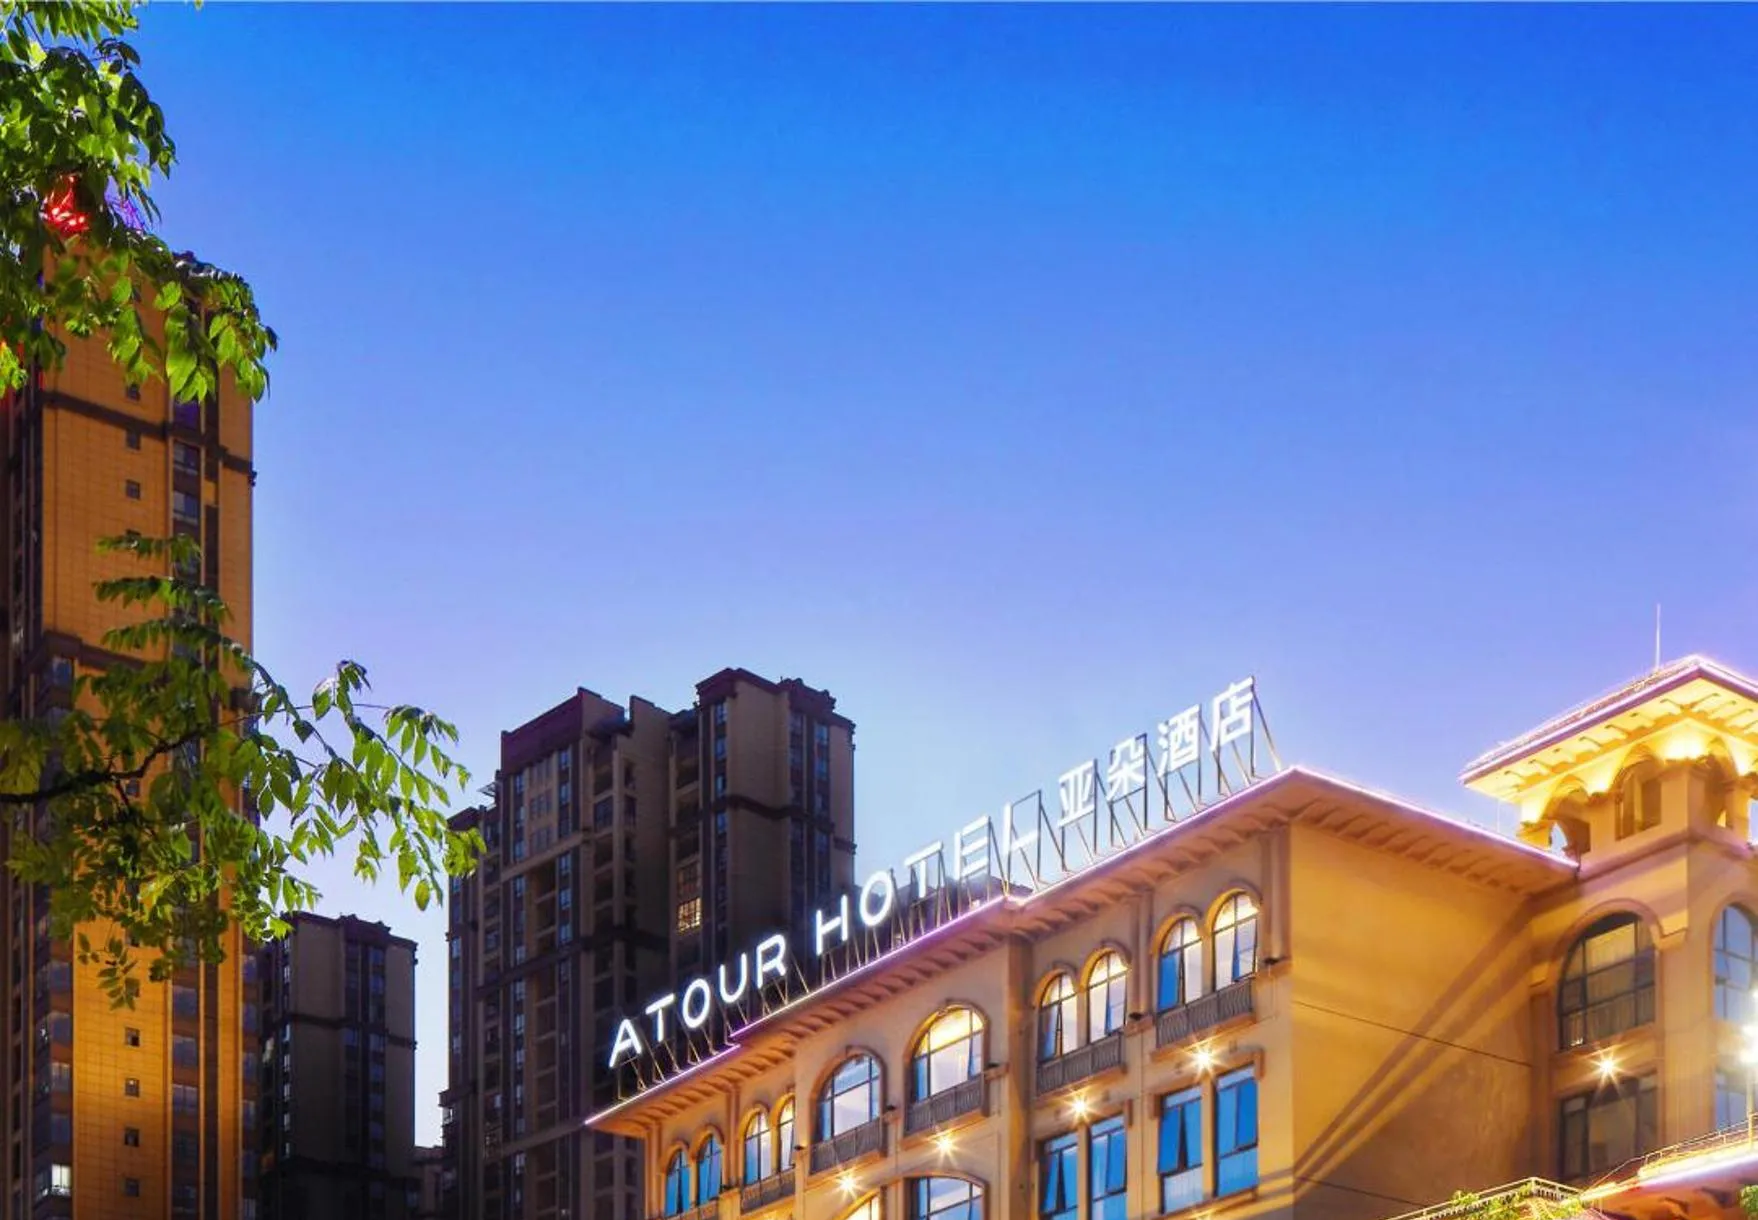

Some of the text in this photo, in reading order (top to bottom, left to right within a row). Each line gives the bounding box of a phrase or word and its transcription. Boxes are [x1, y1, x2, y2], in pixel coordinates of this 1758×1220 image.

[608, 675, 1254, 1068] ATOUR HOTEL 亚朵酒店
